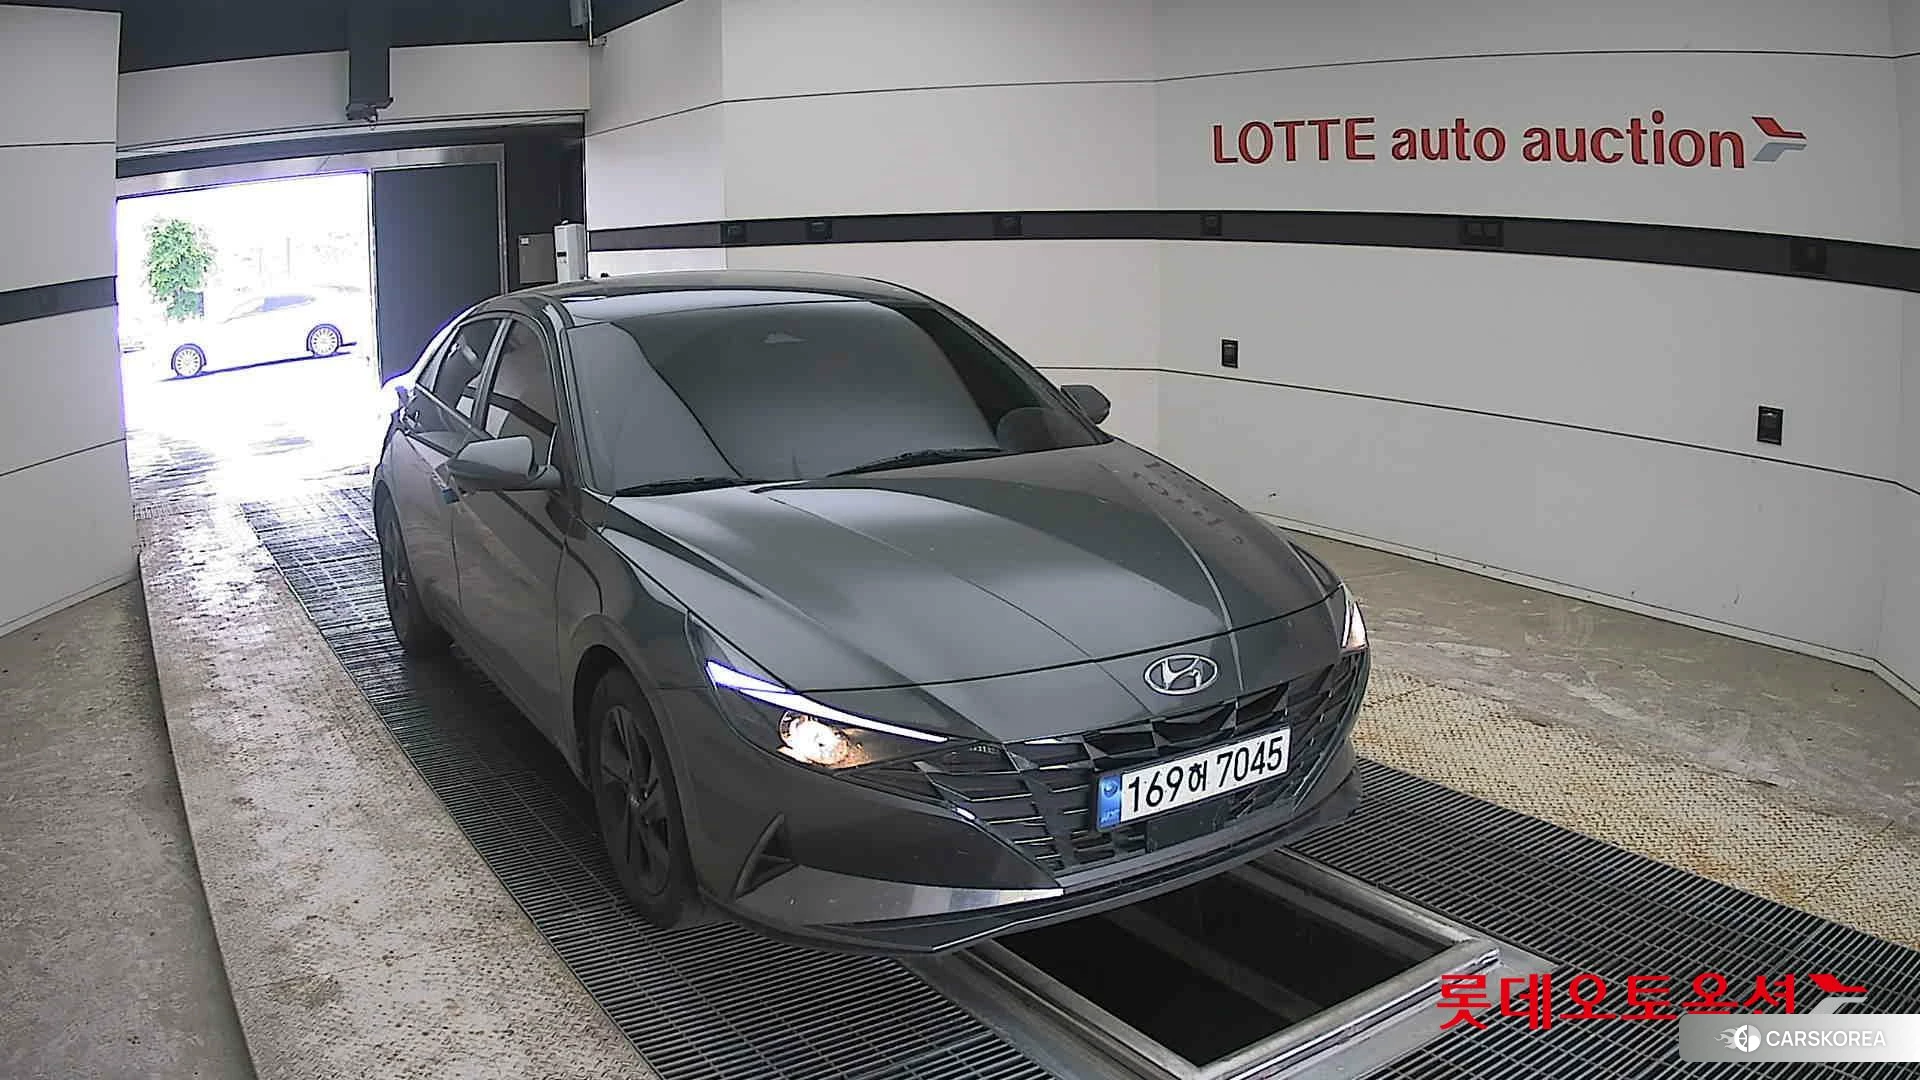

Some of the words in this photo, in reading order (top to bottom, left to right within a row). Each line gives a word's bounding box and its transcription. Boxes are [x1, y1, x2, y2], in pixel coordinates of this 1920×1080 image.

[1213, 117, 1376, 164] LOTTE
[1391, 118, 1506, 161] auto
[1522, 111, 1745, 168] auction
